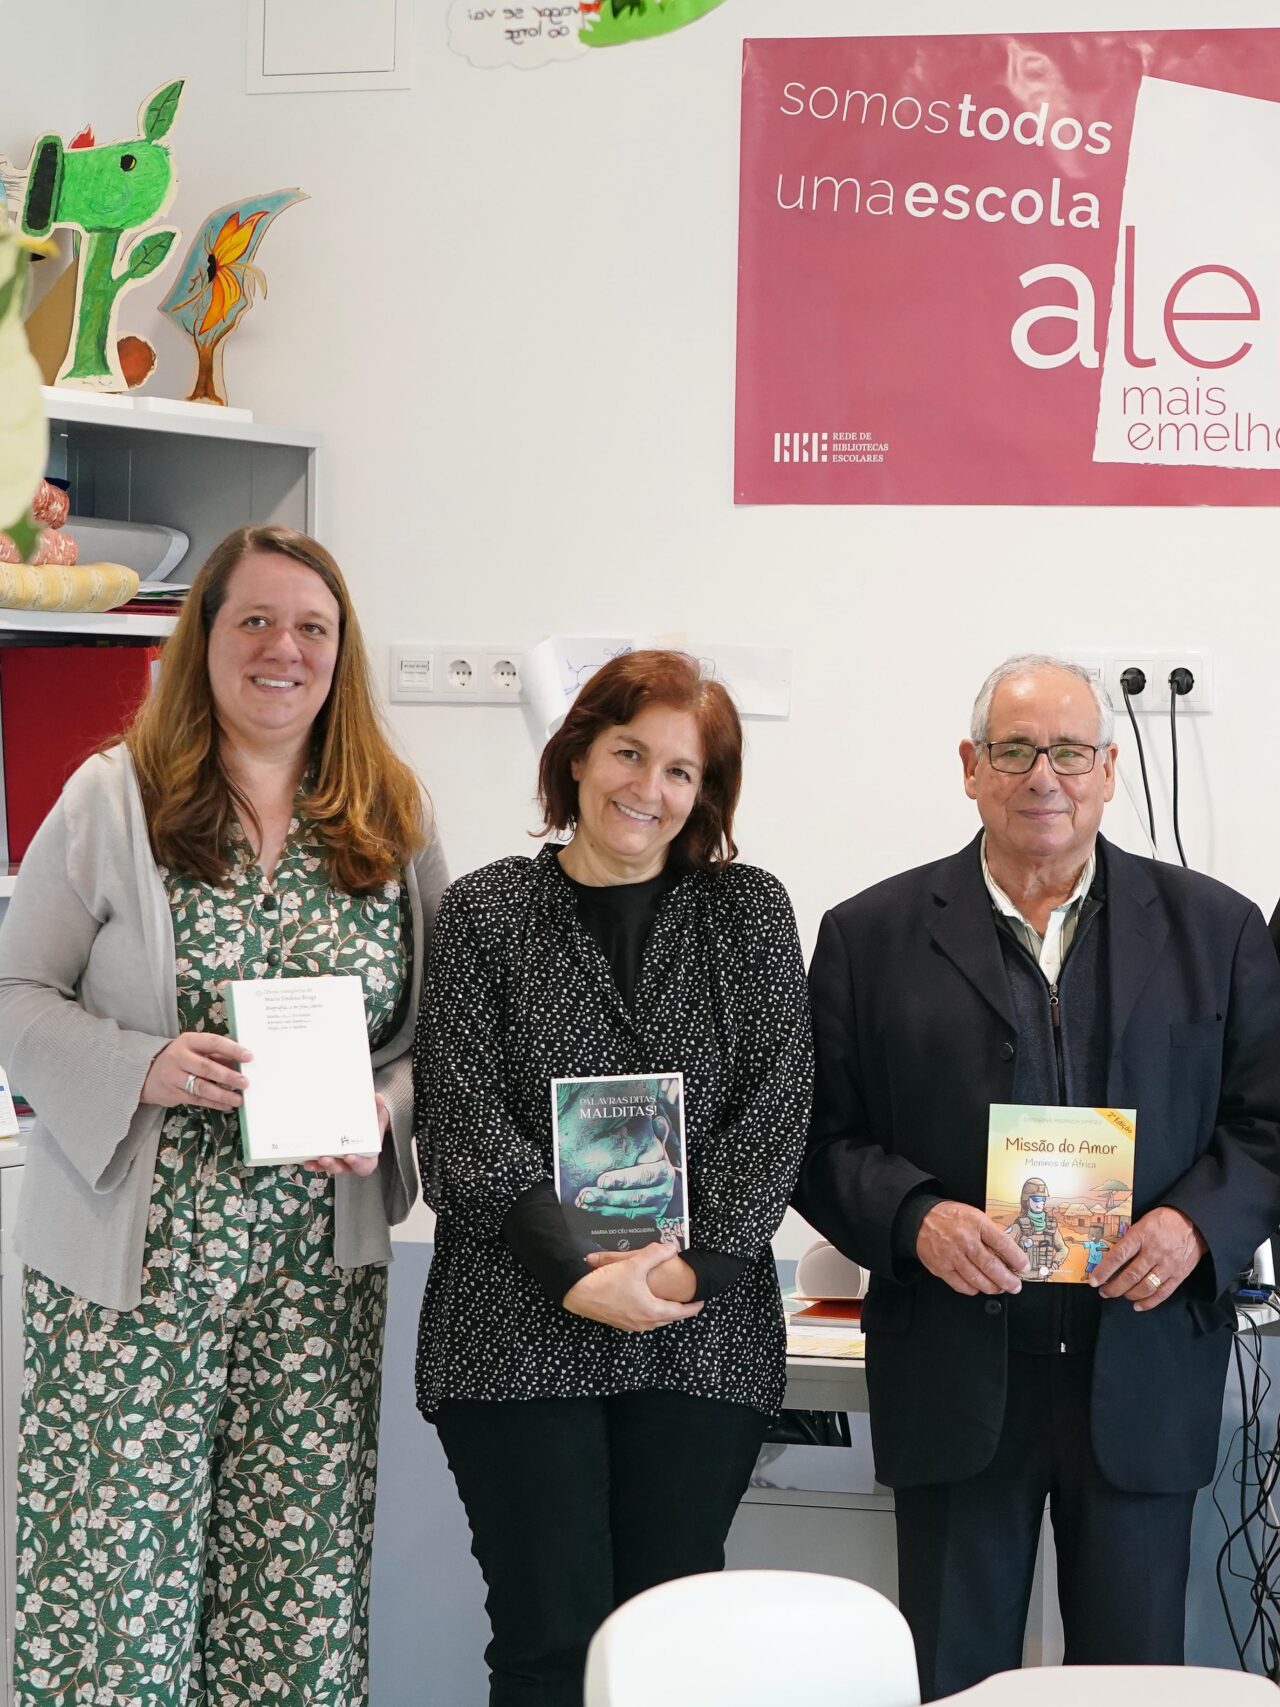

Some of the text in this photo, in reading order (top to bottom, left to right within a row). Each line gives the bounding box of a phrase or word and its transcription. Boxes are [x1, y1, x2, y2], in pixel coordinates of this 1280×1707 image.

[1122, 376, 1227, 416] mais
[832, 432, 872, 440] REDE DE
[832, 443, 889, 452] BIBLIOTECAS
[832, 454, 884, 463] ESCOLARES
[580, 1096, 629, 1106] PALAVRAS
[580, 1105, 658, 1119] MALDITAS!
[1005, 1136, 1118, 1155] Missão do Amor
[1025, 1158, 1059, 1168] Meninos
[1060, 1159, 1071, 1168] de
